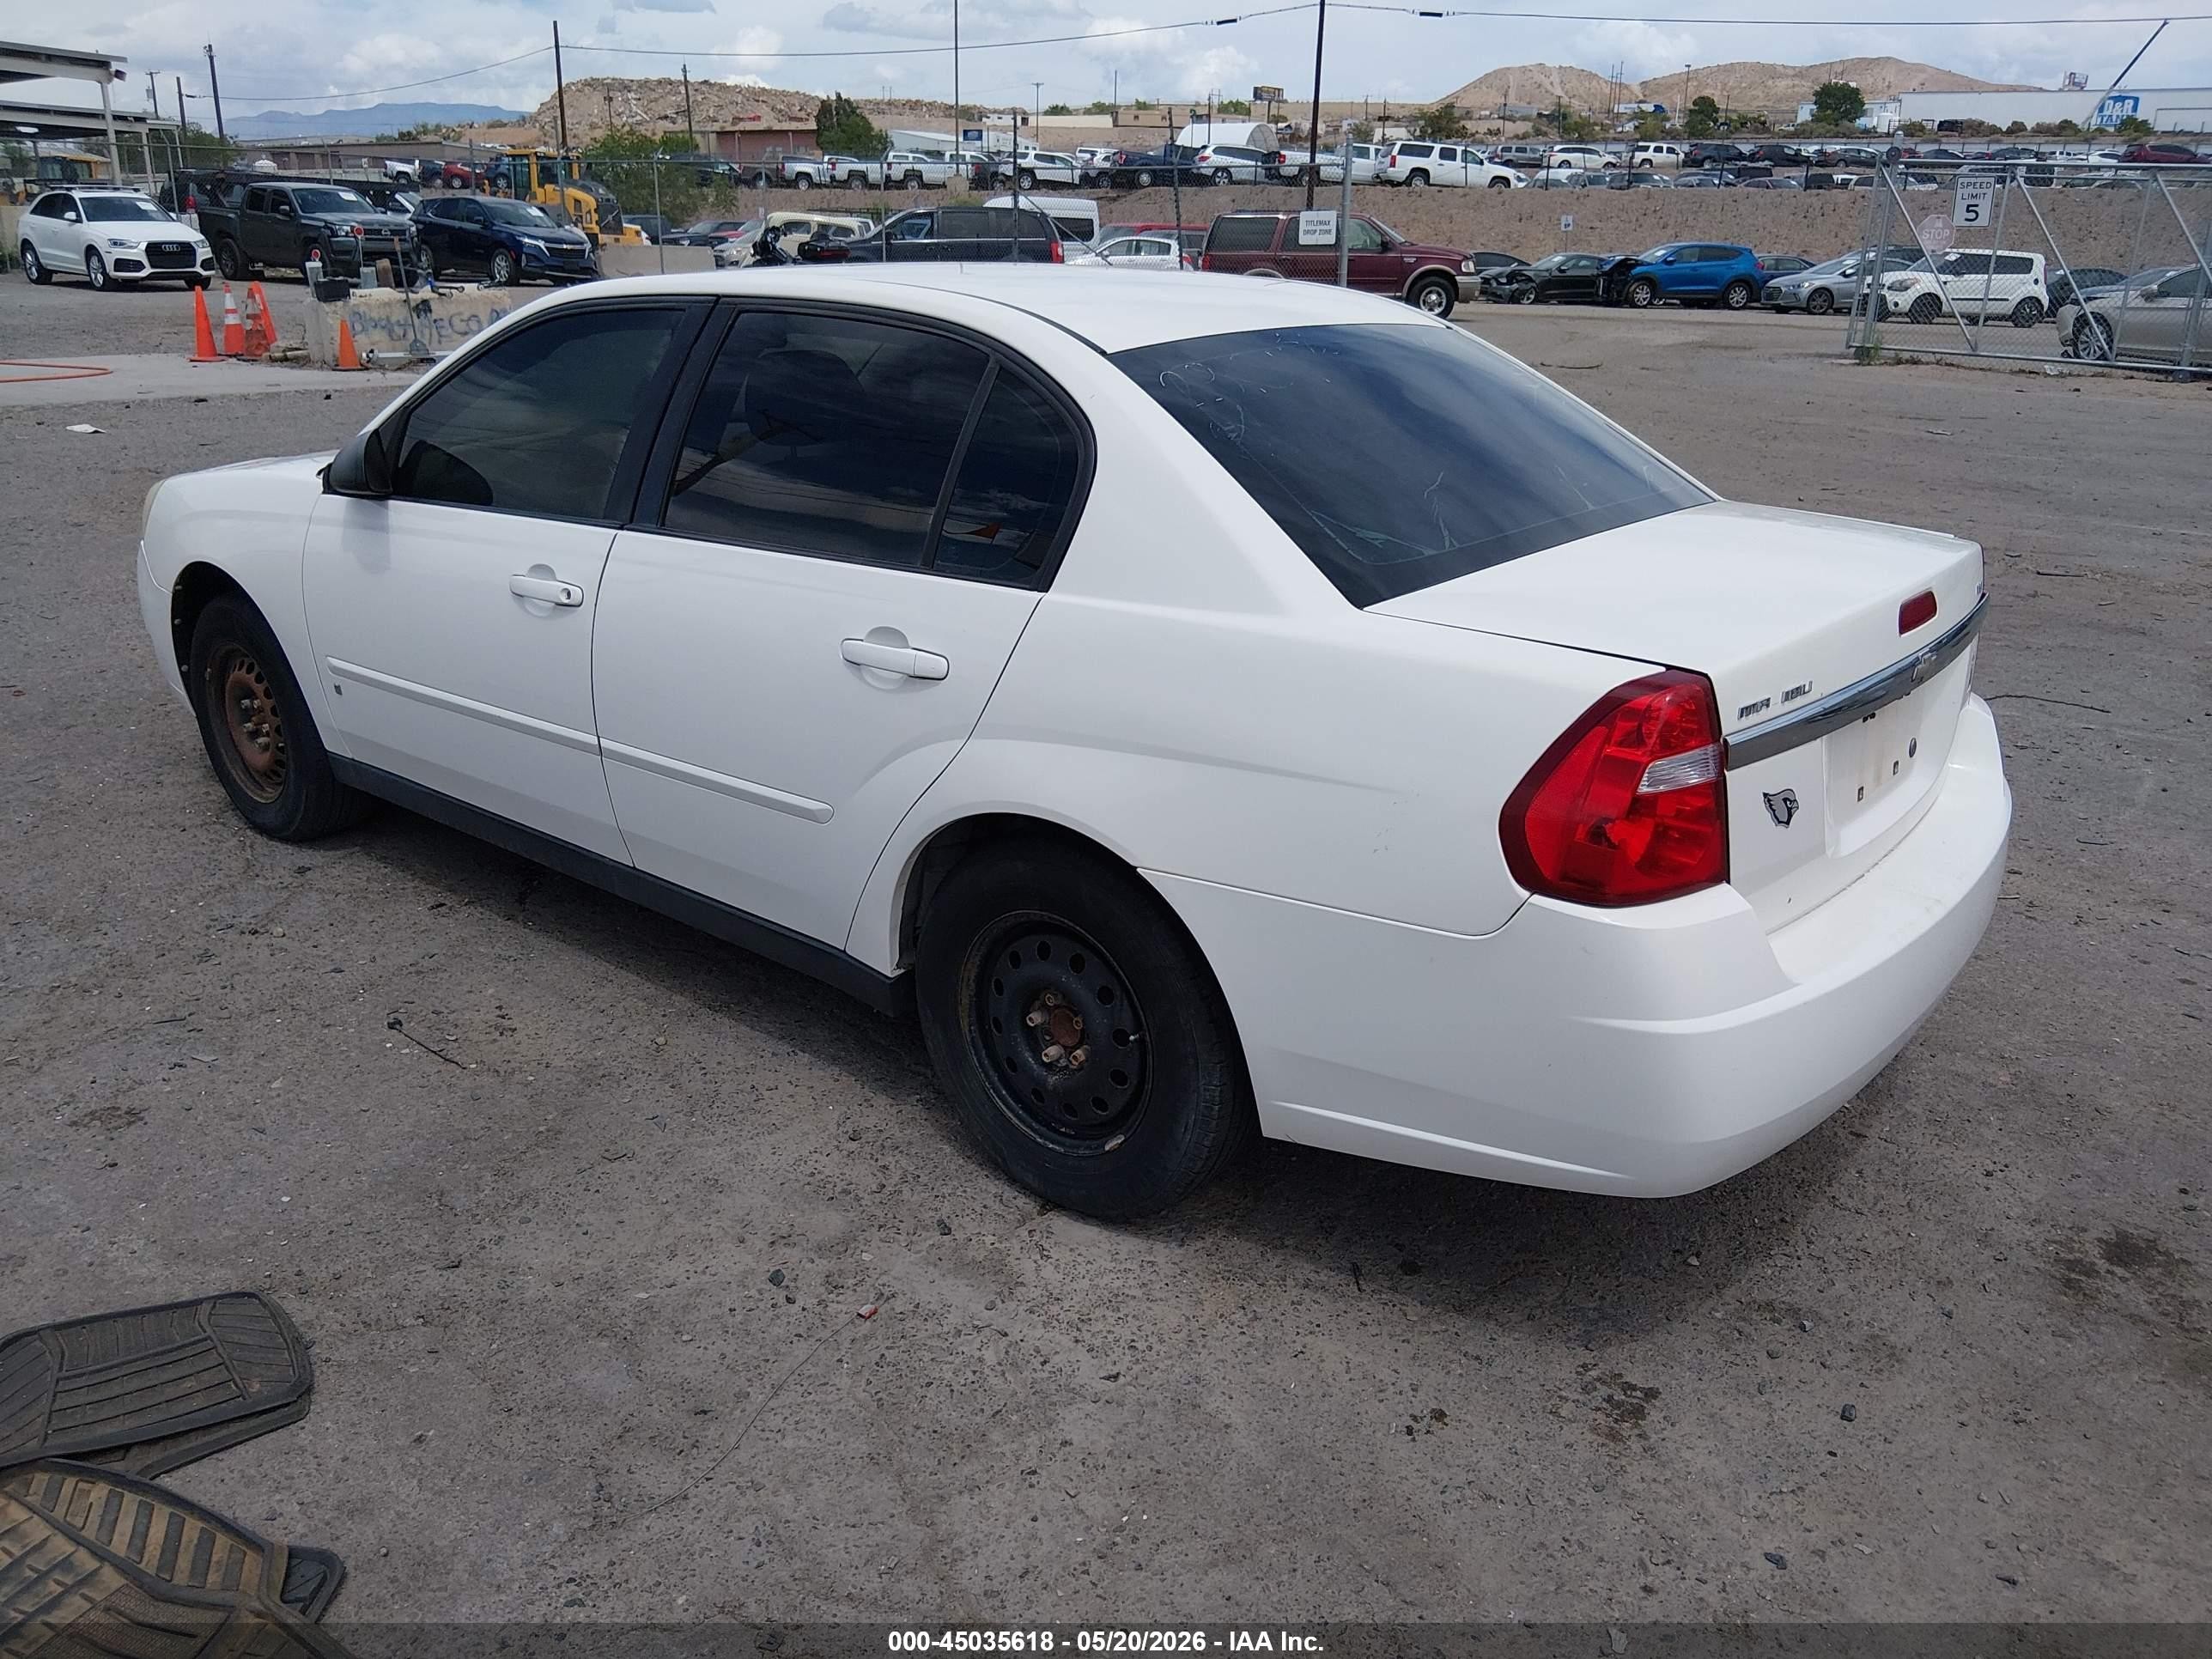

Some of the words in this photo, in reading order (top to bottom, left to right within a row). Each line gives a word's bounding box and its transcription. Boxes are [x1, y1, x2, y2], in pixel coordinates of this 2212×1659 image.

[1960, 181, 1992, 190] SPEED
[1961, 192, 1988, 201] LIMIT
[1965, 204, 1979, 222] 5
[1922, 228, 1950, 240] STOP
